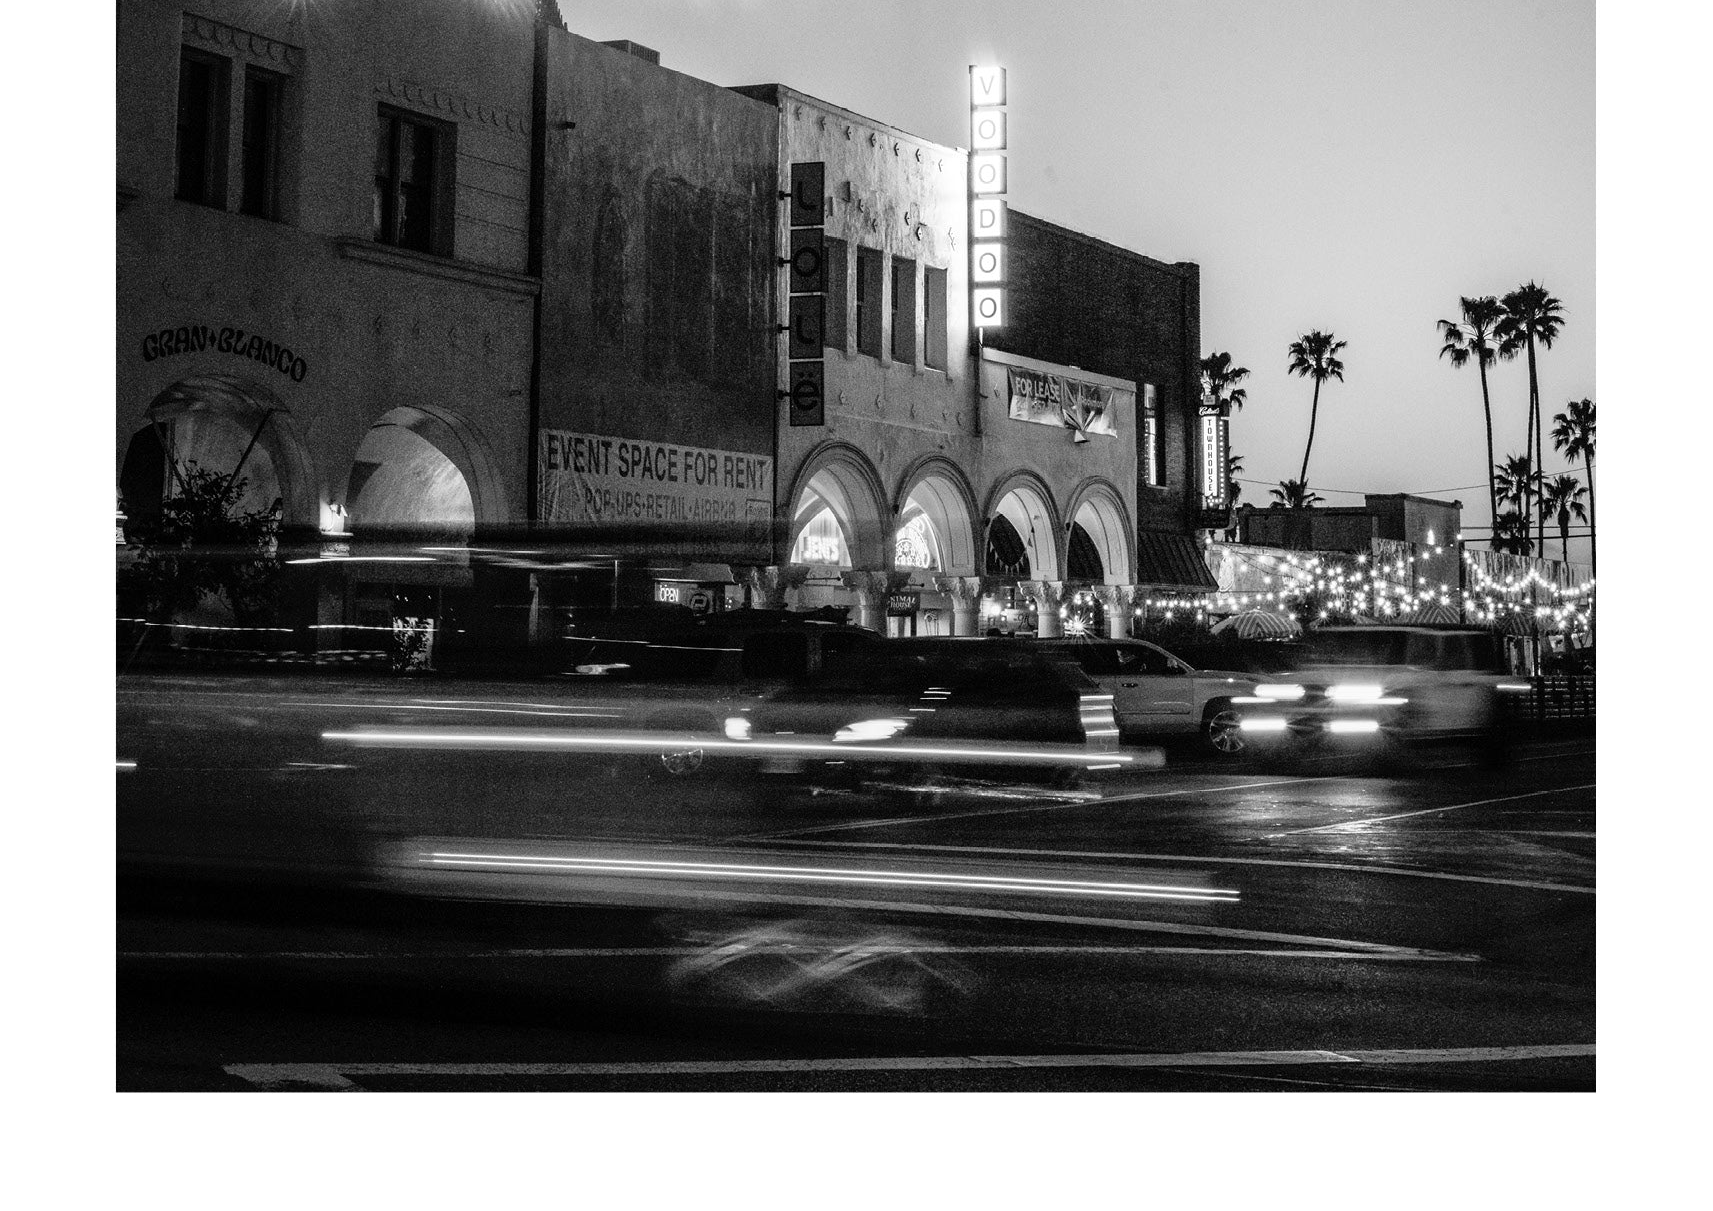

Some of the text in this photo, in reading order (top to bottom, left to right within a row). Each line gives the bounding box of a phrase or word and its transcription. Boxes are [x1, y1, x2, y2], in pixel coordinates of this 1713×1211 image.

[977, 73, 999, 320] VOODOO
[1015, 376, 1033, 398] FOR
[1034, 380, 1060, 403] LEASE
[548, 433, 767, 491] EVENT SPACE FOR RENT
[1206, 419, 1214, 492] TOWNHOUSE
[659, 587, 679, 603] OPEN
